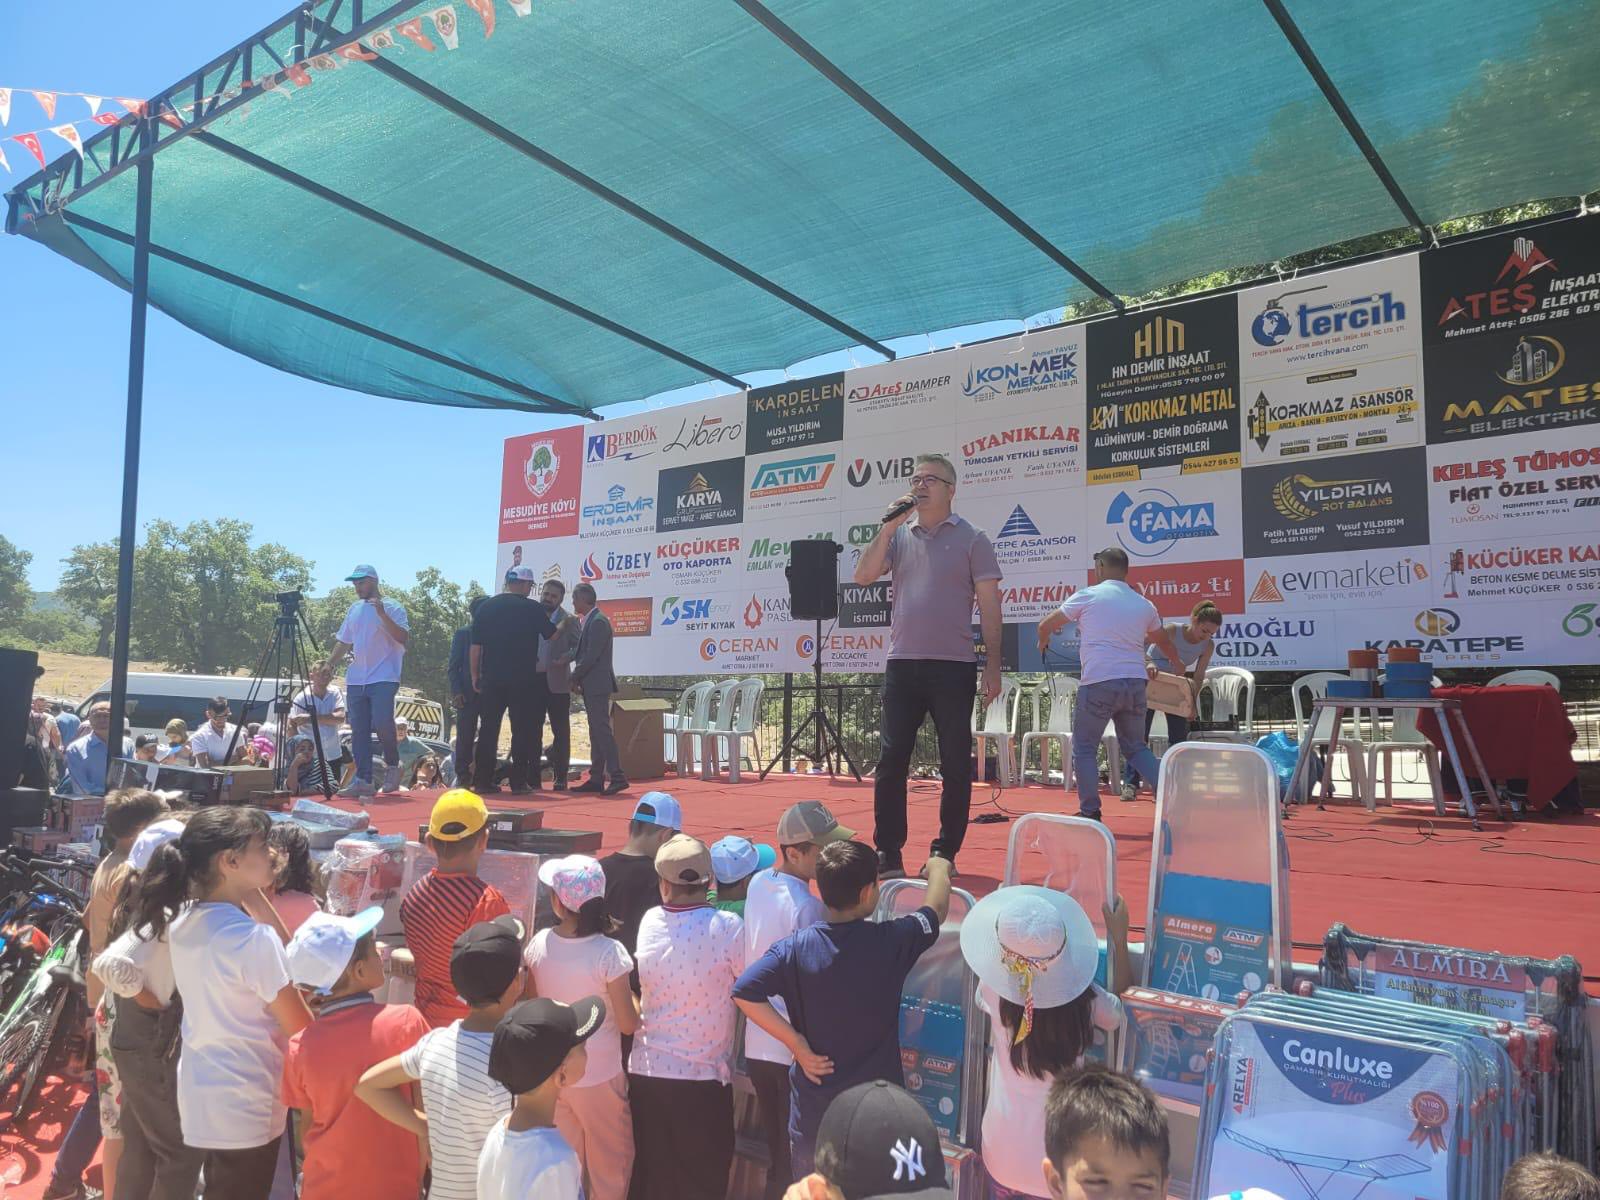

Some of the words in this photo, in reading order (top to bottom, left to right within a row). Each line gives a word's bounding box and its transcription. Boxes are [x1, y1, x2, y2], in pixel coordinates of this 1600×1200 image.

[1297, 292, 1406, 338] tercih
[1438, 283, 1537, 327] ATEŞ
[1445, 324, 1486, 338] Mehmet
[1519, 312, 1546, 325] 0506
[1549, 308, 1570, 319] 286
[1576, 304, 1591, 315] 60
[1286, 343, 1369, 363] www.tercihvana.com
[976, 351, 1078, 384] KON-MEK
[1112, 365, 1127, 379] HN
[1130, 357, 1165, 376] DEMİR
[1168, 350, 1211, 369] İNŞAAT
[905, 375, 951, 392] DAMPER
[755, 382, 844, 413] KARDELEN
[1124, 395, 1188, 425] KORKMAZ
[1190, 387, 1236, 415] METAL
[1269, 397, 1345, 421] KORKMAZ
[1350, 386, 1414, 410] ASANSÖR
[1362, 407, 1390, 418] MONTAJ
[662, 415, 742, 452] Libero
[766, 427, 787, 438] MUSA
[788, 420, 821, 435] YILDIRIM
[1094, 430, 1146, 448] ALÜMİNYUM
[1152, 424, 1182, 440] DEMİR
[1183, 419, 1229, 434] DOĞRAMA
[607, 425, 658, 458] BERDÖK
[962, 426, 1080, 457] UYANIKLAR
[1111, 446, 1157, 463] KORKULUK
[1157, 437, 1210, 457] SİSTEMLERİ
[762, 466, 818, 488] ATM
[1433, 458, 1506, 482] KELEŞ
[676, 490, 722, 509] KARYA
[1299, 480, 1393, 502] YILDIRIM
[1498, 480, 1549, 498] ÖZEL
[503, 502, 549, 519] MESUDİYE
[550, 496, 577, 513] KÖYÜ
[583, 496, 654, 518] ERDEMİR
[1322, 501, 1344, 512] ROT
[1346, 497, 1393, 509] BALANS
[1141, 507, 1212, 532] FAMA
[1336, 522, 1361, 531] Yusuf
[1363, 518, 1405, 529] YILDIRIM
[1021, 536, 1077, 548] ASANSÖR
[1263, 529, 1284, 538] Fatih
[1286, 526, 1325, 536] YILDIRIM
[656, 537, 740, 560] KÜÇÜKER
[606, 551, 651, 571] ÖZBEY
[663, 562, 683, 571] OTO
[685, 557, 732, 569] KAPORTA
[746, 560, 774, 572] EMLAK
[1470, 575, 1503, 585] BETON
[1505, 572, 1540, 583] KESME
[1542, 569, 1577, 580] DELME
[843, 586, 882, 604] KIYAK
[1468, 588, 1505, 597] Mehmet
[1509, 584, 1561, 596] KÜÇÜKER
[1576, 582, 1593, 591] 536
[686, 621, 709, 631] SEYİT
[710, 621, 736, 630] KIYAK
[853, 610, 887, 623] ismail
[719, 637, 779, 653] CERAN
[1216, 641, 1279, 657] GIDA
[1229, 930, 1257, 943] ATM
[1391, 949, 1512, 983] ALMIRA
[1282, 1039, 1393, 1080] Canluxe
[1329, 1080, 1367, 1104] Plus
[890, 1137, 926, 1181] NY
